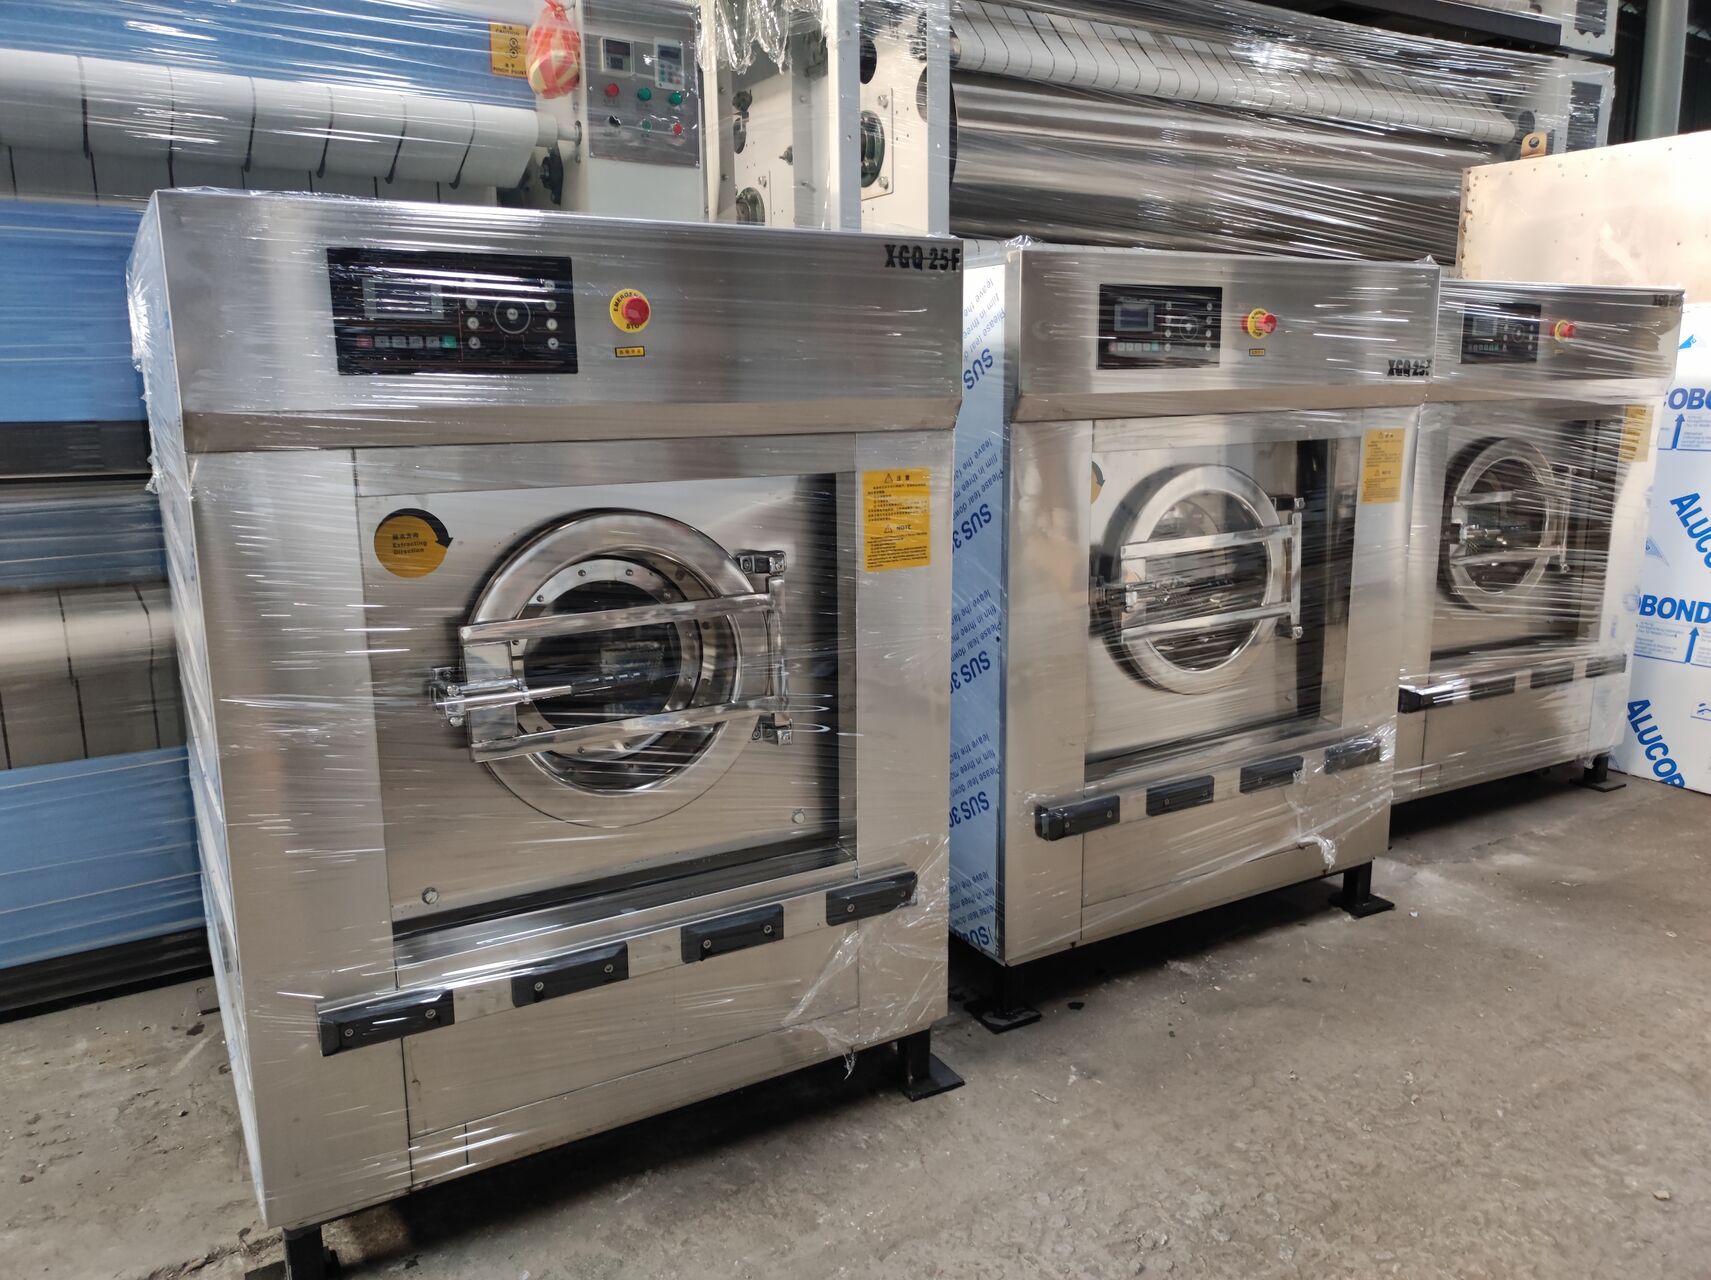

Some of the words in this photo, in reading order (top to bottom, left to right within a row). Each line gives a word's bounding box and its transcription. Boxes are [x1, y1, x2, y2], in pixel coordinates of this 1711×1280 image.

[963, 348, 993, 390] SUS
[974, 437, 993, 459] leave
[962, 456, 974, 470] the
[977, 465, 985, 476] in
[985, 453, 998, 469] film
[961, 473, 978, 492] three
[980, 469, 1004, 493] Please
[967, 490, 981, 505] tear
[961, 503, 992, 541] SUS
[973, 589, 992, 608] leave
[961, 604, 973, 617] the
[980, 620, 1002, 641] Please
[960, 650, 991, 684] SUS
[971, 732, 990, 748] leave
[960, 791, 990, 820] SUS
